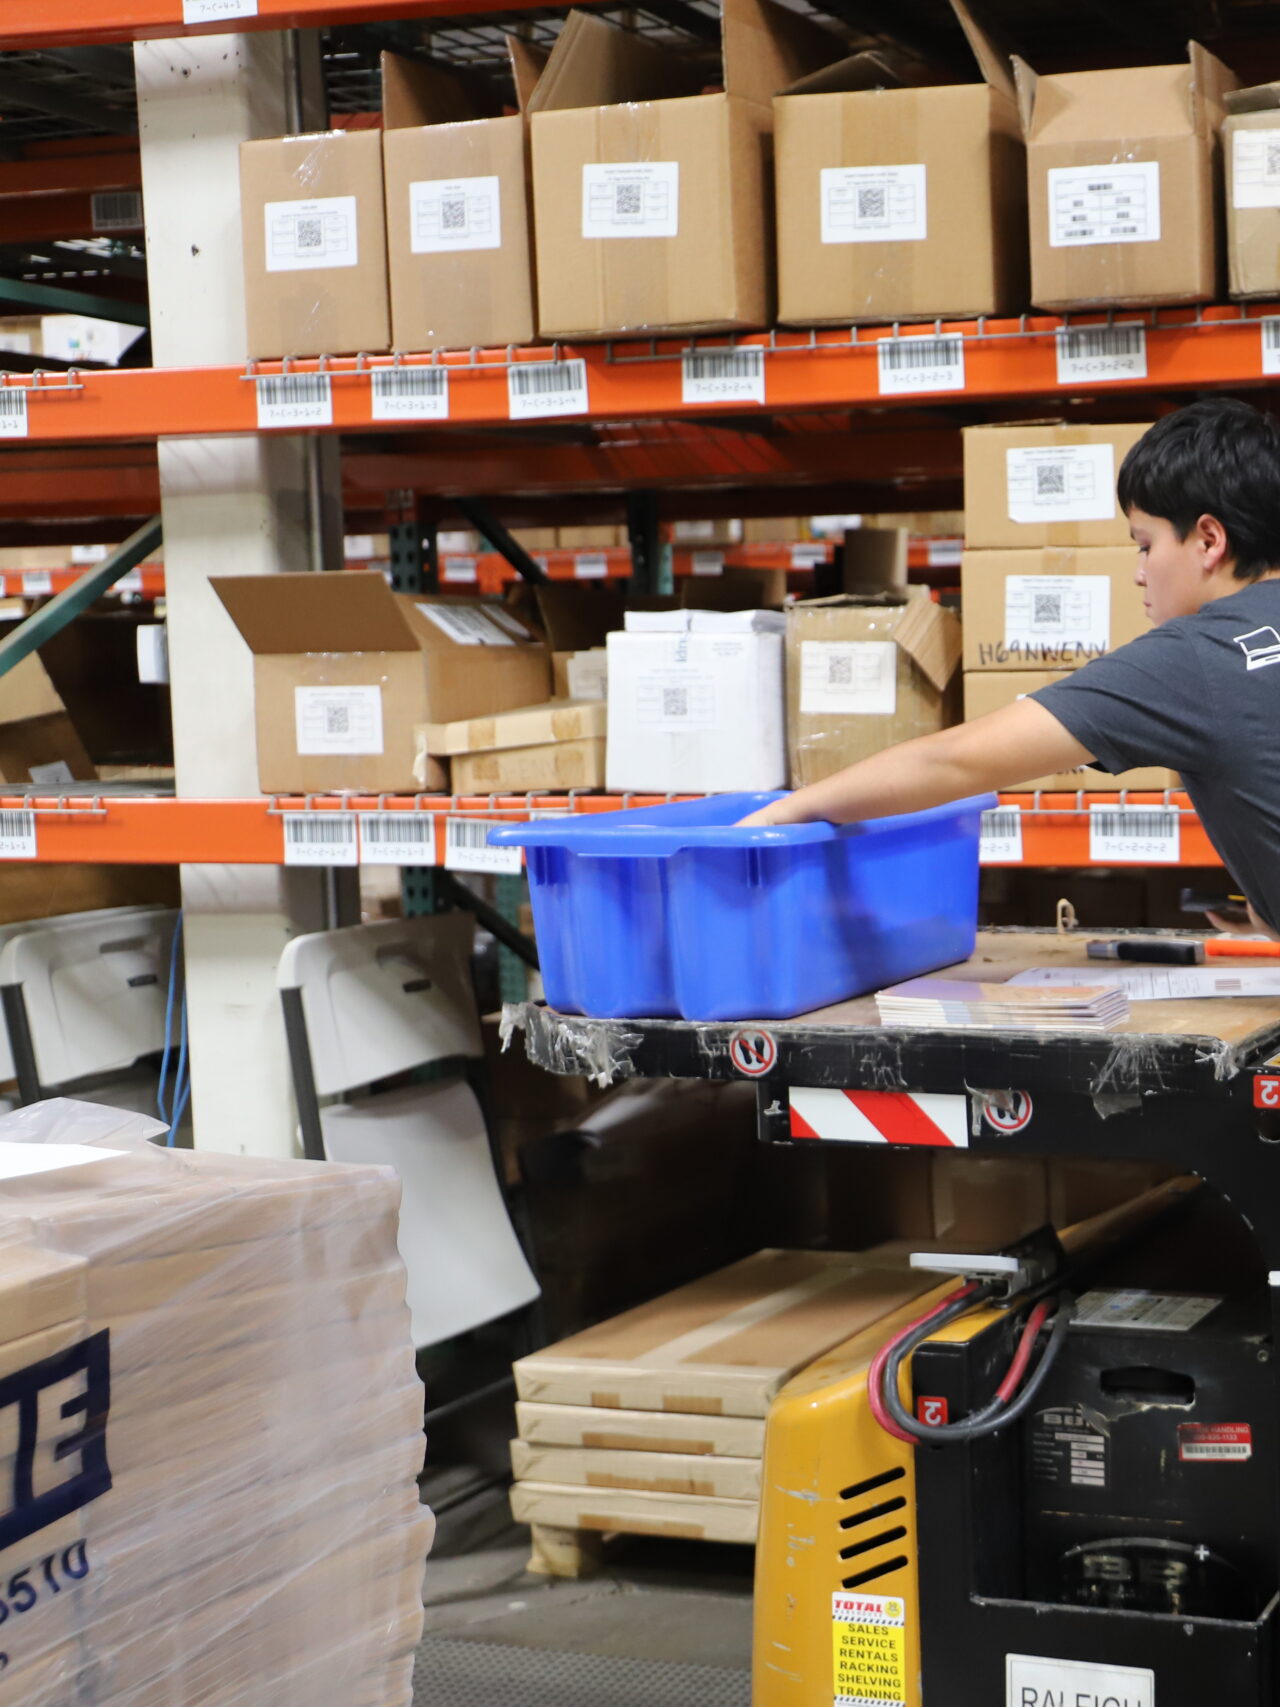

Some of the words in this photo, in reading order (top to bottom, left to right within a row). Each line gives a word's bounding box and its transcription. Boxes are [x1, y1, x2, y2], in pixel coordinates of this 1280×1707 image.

[834, 1600, 883, 1613] TOTAL
[848, 1623, 889, 1636] SALES
[841, 1635, 896, 1649] SERVICE
[840, 1648, 898, 1662] RENTALS
[840, 1661, 898, 1675] RACKING
[838, 1673, 901, 1688] SHELVING
[838, 1686, 901, 1700] TRAINING
